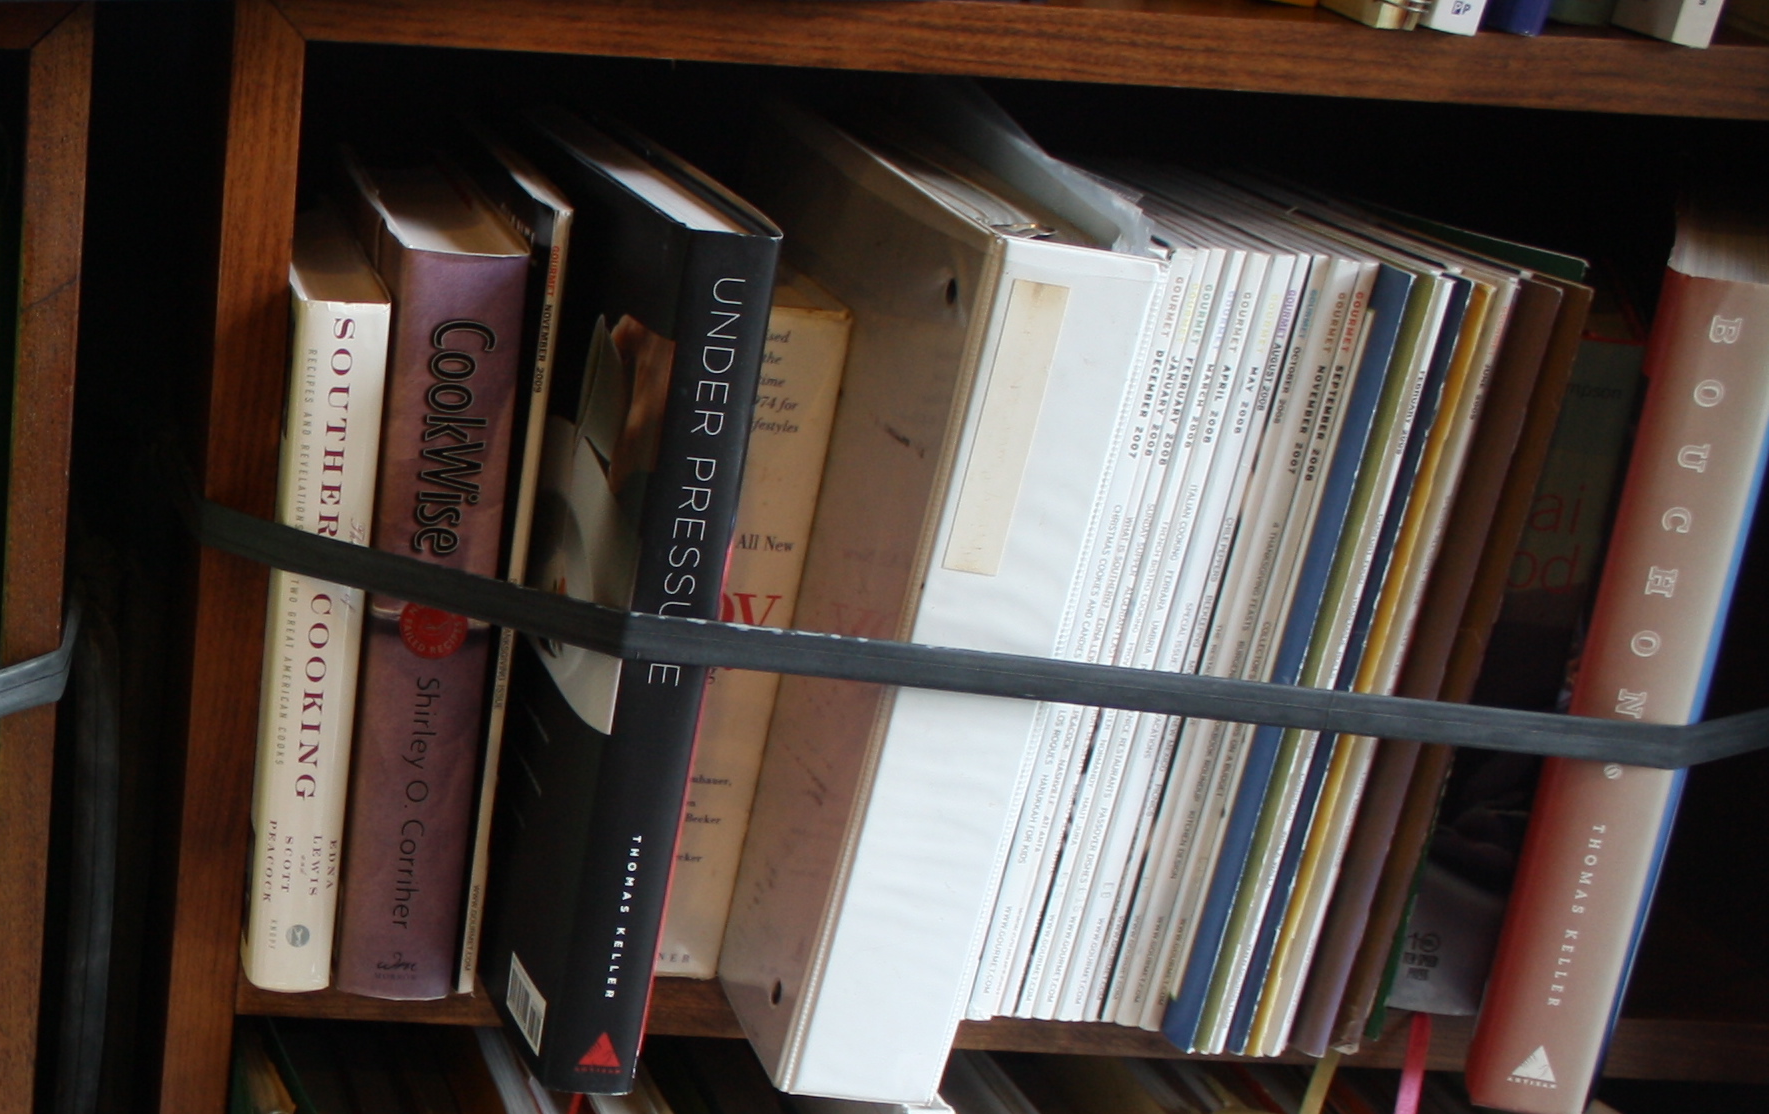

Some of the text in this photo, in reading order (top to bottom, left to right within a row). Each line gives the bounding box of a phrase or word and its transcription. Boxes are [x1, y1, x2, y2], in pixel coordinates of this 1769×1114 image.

[539, 245, 560, 362] GOURMET NOVEMBER
[690, 277, 746, 436] UNDER
[1128, 350, 1165, 460] DECEMBER 2007
[1145, 356, 1179, 457] JANUARY 2008
[1159, 284, 1213, 466] GOURMET FEBRUARY 2008
[1184, 364, 1215, 448] MARCH 2008
[1203, 292, 1251, 444] GOURMET APRIL 2008
[1234, 366, 1259, 434] MAY 2008
[1257, 342, 1281, 411] AUGUST 2008
[1282, 346, 1301, 393] OCTOBER
[1287, 365, 1326, 475] NOVEMBER 2007
[1305, 291, 1364, 482] GOURMET SEPTEMBER 2008
[413, 319, 497, 556] CookWise
[274, 348, 318, 765] RECIPES GREAT AMERICAN COOKS
[736, 534, 793, 552] All New
[1615, 314, 1743, 719] BOUCHON
[294, 593, 332, 801] COOKING
[402, 677, 440, 770] Shirley
[263, 820, 278, 902] PEACOCK
[281, 836, 293, 894] SCOTT
[308, 835, 323, 896] LEWIS
[325, 840, 338, 889] EDNA
[392, 819, 425, 930] Corriher
[1547, 825, 1606, 1007] THOMAS KELLER
[605, 835, 642, 999] THOMAS KELLER
